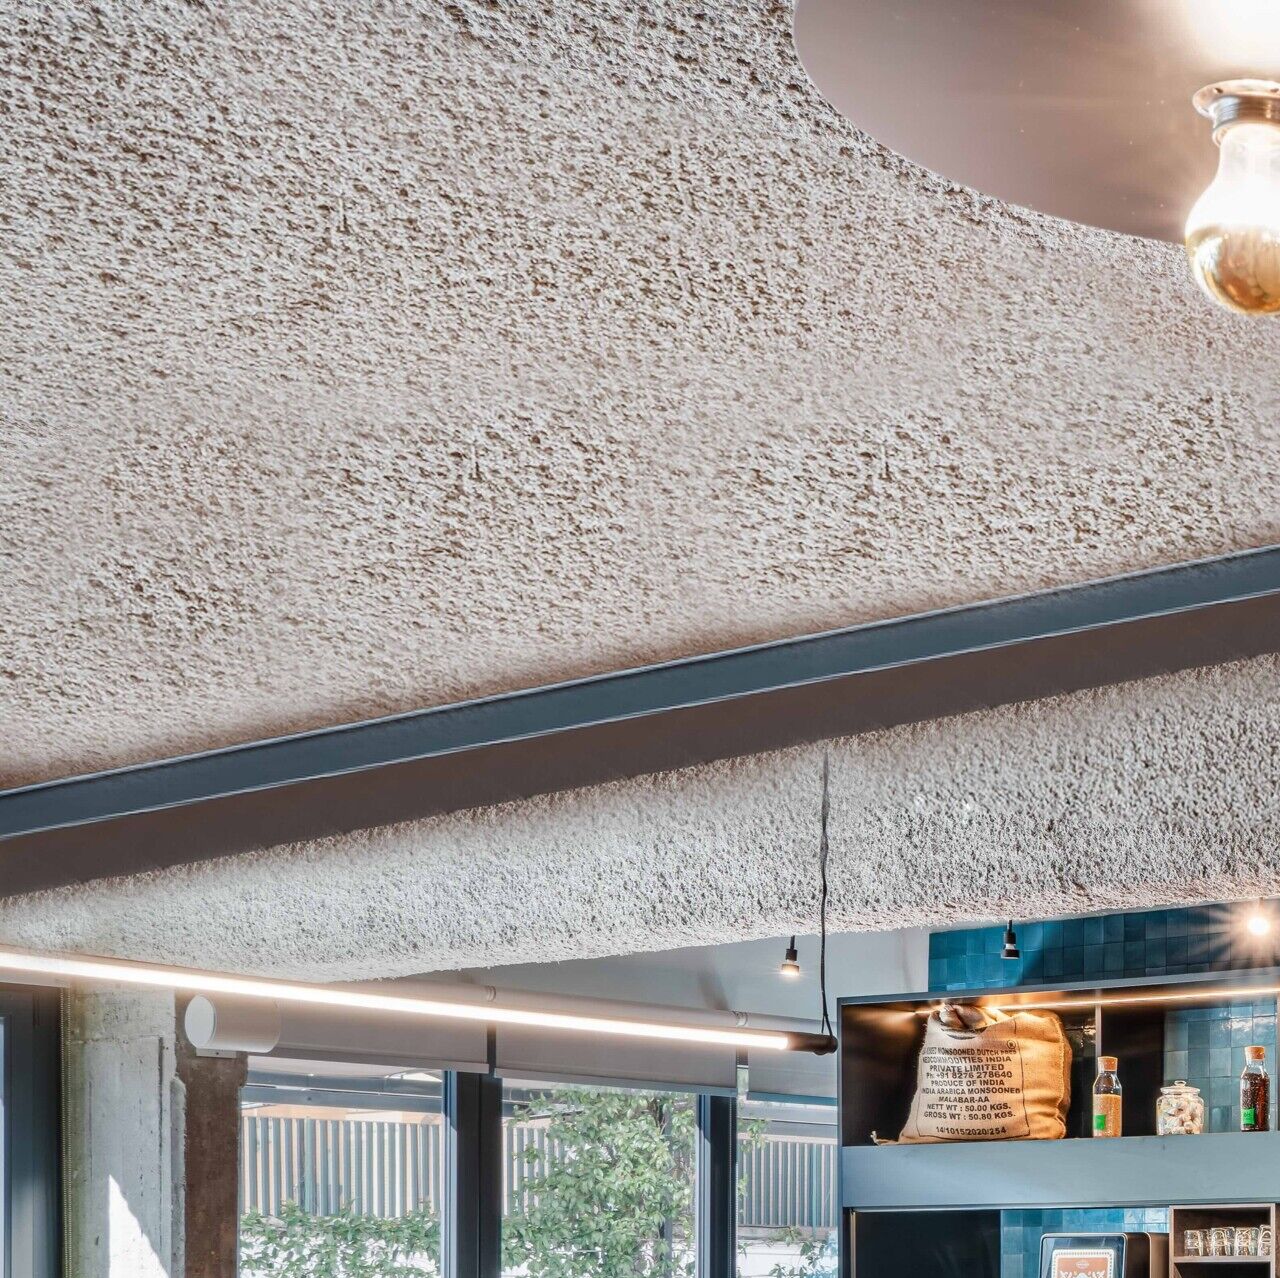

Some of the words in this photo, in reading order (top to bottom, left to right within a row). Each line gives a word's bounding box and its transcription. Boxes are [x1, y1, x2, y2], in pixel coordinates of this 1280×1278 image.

[929, 1064, 962, 1073] PRIVATE
[965, 1063, 1005, 1072] LIMITED
[976, 1071, 1013, 1079] 278640
[980, 1079, 1005, 1087] INDIA
[968, 1087, 1021, 1095] MONSOONED
[938, 1096, 990, 1104] MALABAR-AA
[946, 1104, 958, 1112] WT
[965, 1104, 987, 1112] 50.00
[989, 1103, 1012, 1111] KGS.
[923, 1111, 947, 1119] GROSS
[948, 1112, 961, 1120] WT
[968, 1113, 992, 1121] 50.80
[994, 1111, 1017, 1119] KGS.
